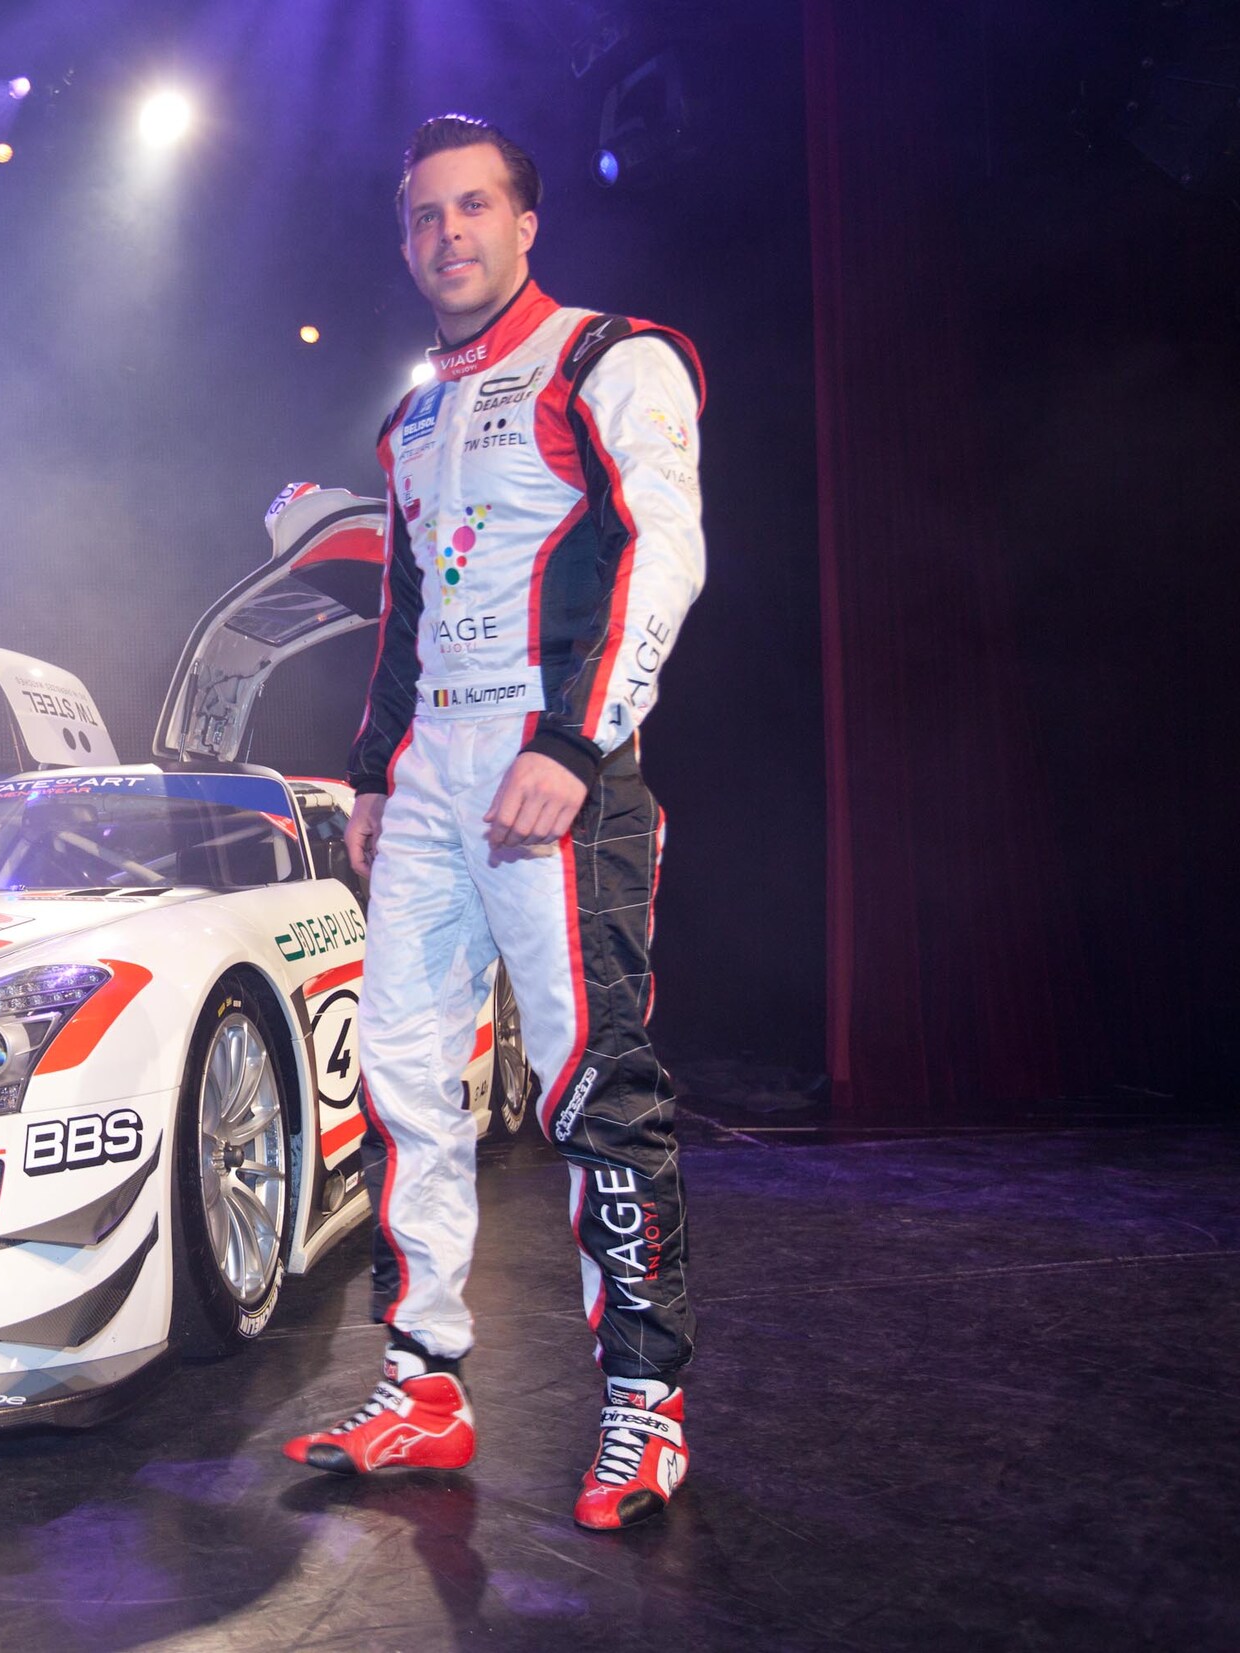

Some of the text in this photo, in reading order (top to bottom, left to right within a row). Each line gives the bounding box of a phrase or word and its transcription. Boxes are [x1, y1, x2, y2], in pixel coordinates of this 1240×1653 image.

[440, 345, 488, 371] VIAGE
[464, 433, 527, 452] TW STEEL
[22, 690, 98, 726] TW STEEL
[451, 684, 527, 705] A. Kumpen
[79, 778, 145, 787] ART
[326, 1016, 354, 1079] 4
[23, 1108, 144, 1177] BBS
[594, 1167, 652, 1311] VIAGE
[643, 1202, 660, 1281] ENJOY!
